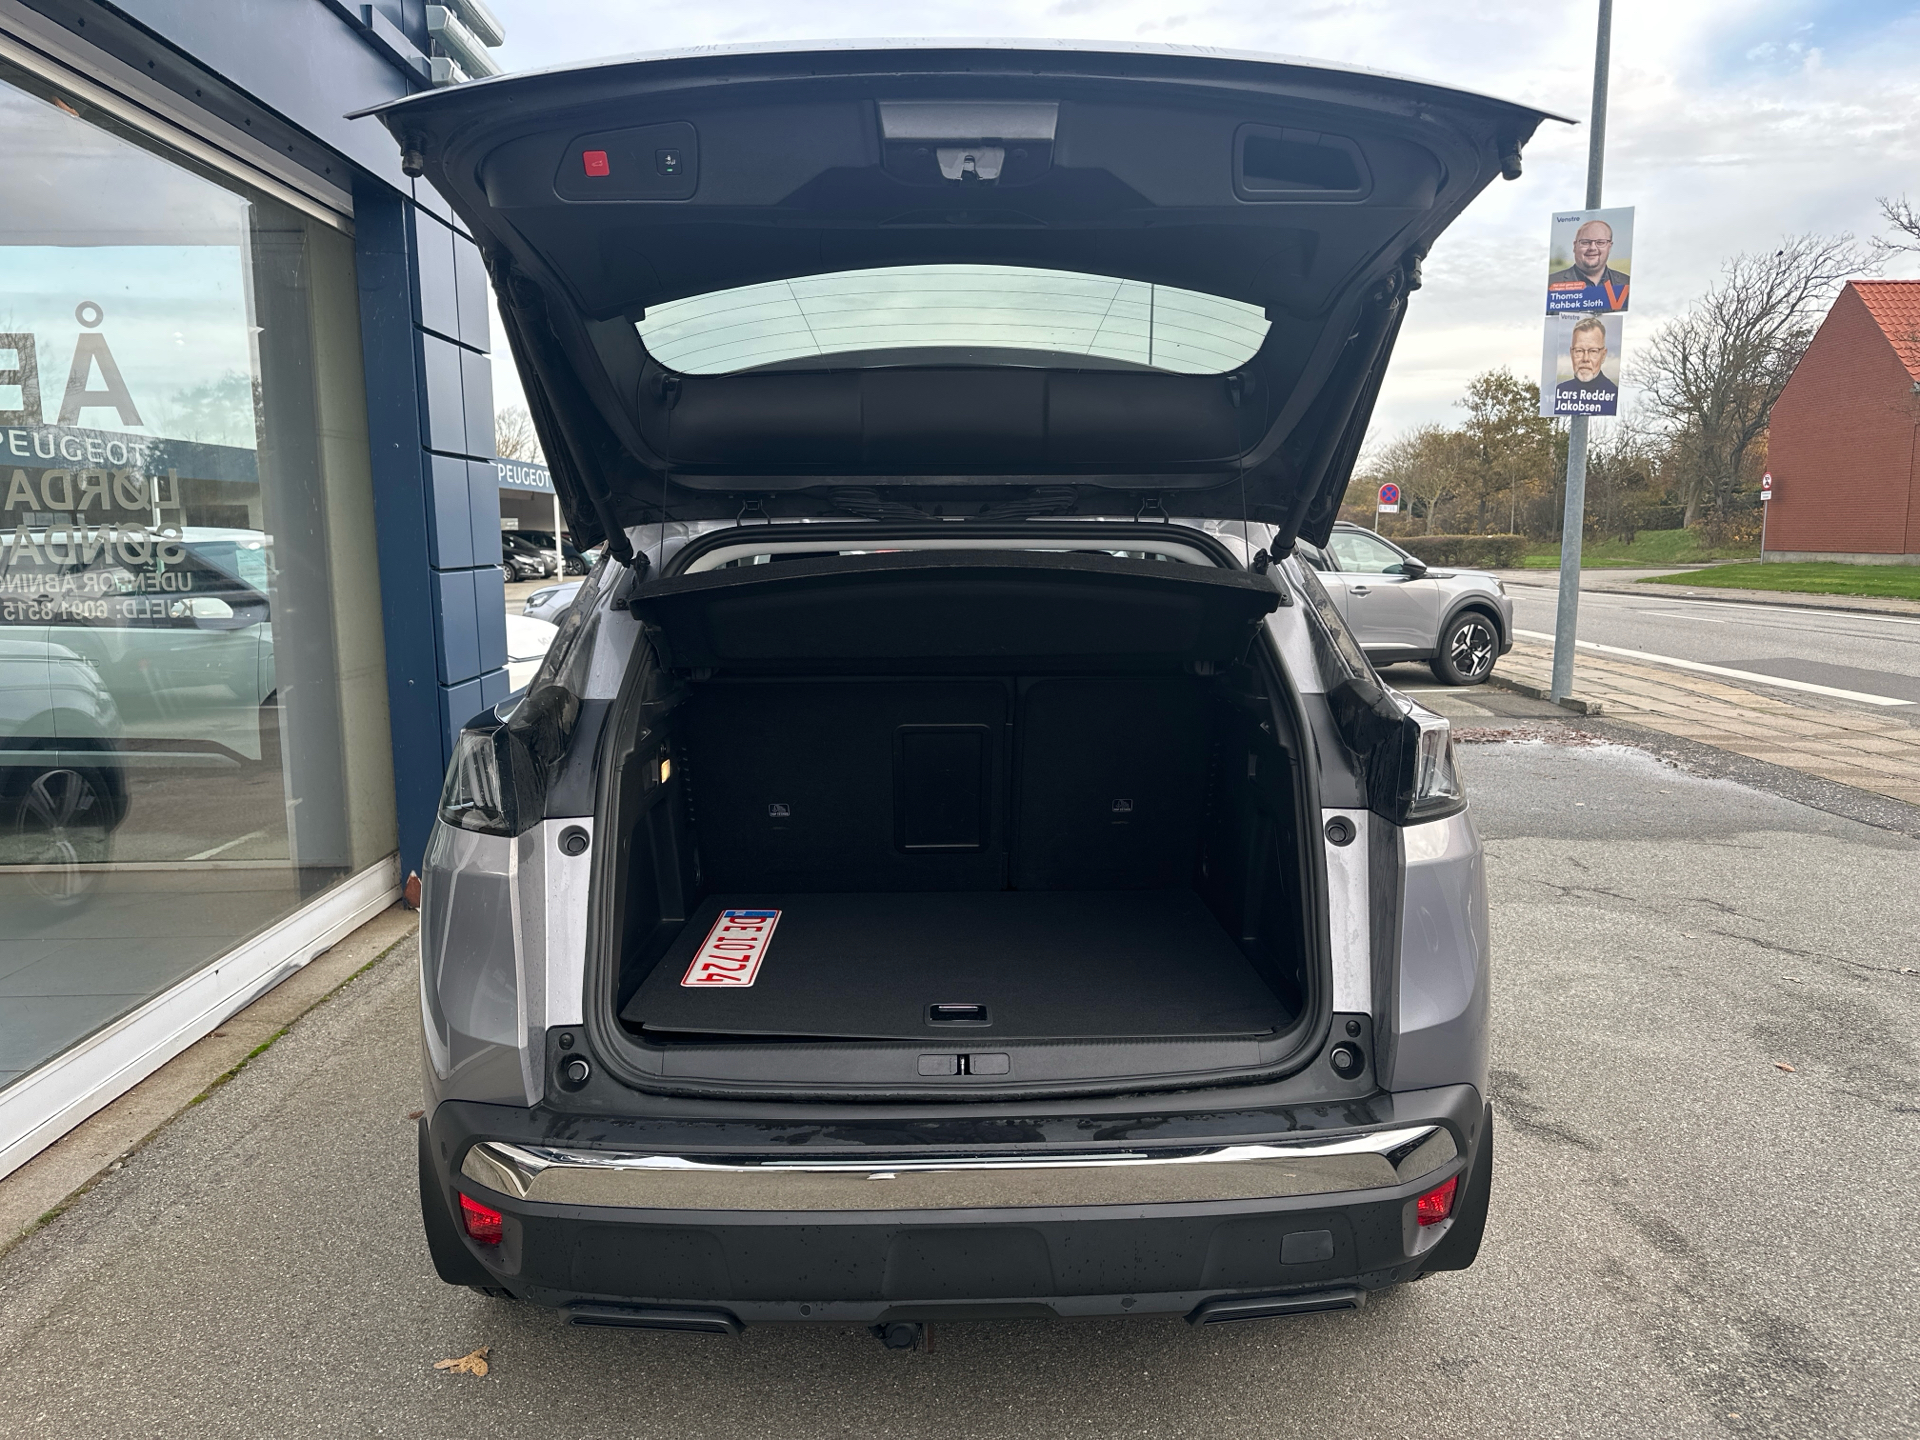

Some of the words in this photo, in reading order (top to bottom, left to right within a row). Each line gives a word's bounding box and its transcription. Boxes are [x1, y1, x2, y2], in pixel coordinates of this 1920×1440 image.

[1551, 292, 1583, 300] Thomas
[1604, 280, 1630, 310] V
[1550, 300, 1581, 309] Rahbek
[1582, 299, 1604, 307] Sloth
[1556, 388, 1577, 400] Lars
[1580, 389, 1615, 401] Redder
[1555, 400, 1601, 412] Jakobsen
[0, 429, 147, 467] EUGEOT
[497, 463, 550, 488] PEUGEOT
